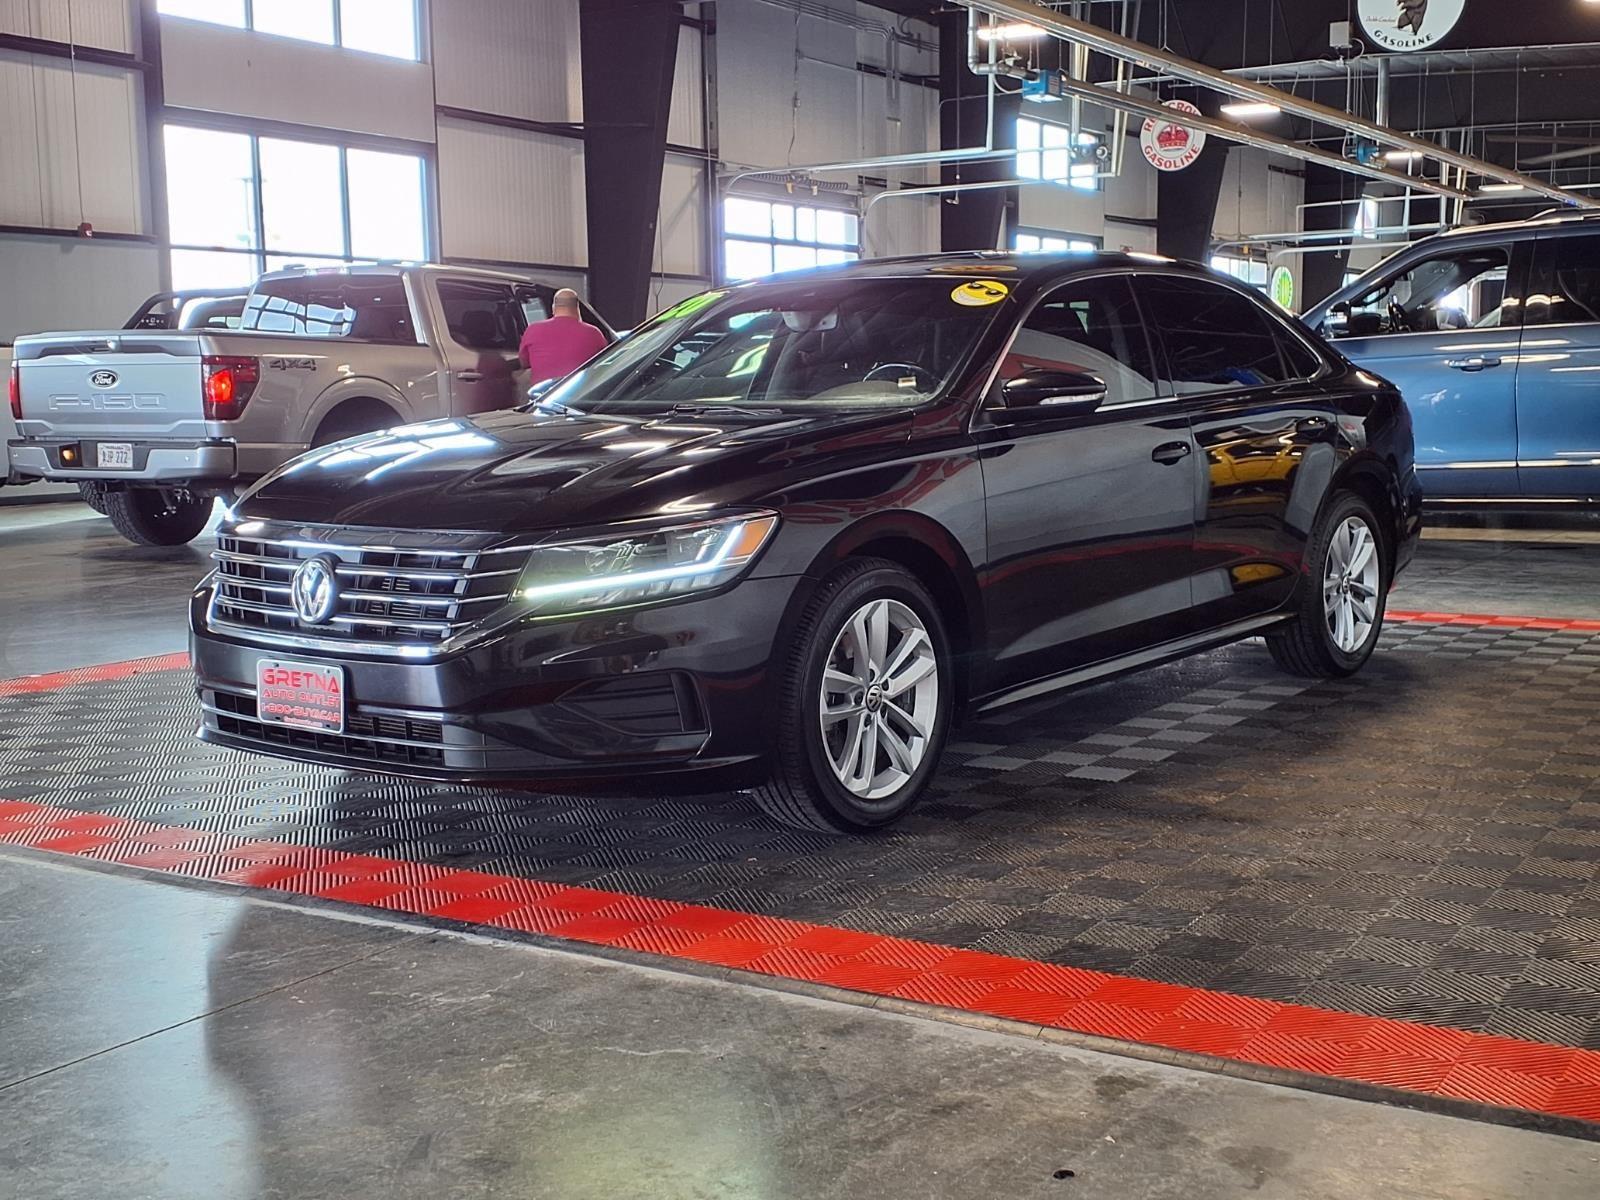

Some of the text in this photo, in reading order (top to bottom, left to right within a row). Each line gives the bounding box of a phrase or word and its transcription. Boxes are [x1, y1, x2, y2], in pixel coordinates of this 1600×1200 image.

[1374, 33, 1433, 47] GASOLINE
[1144, 144, 1200, 169] GASOLINE
[94, 372, 114, 385] Ford
[49, 393, 167, 410] F-150
[263, 668, 339, 694] GRETNA
[262, 687, 341, 708] AUTO OUTLET
